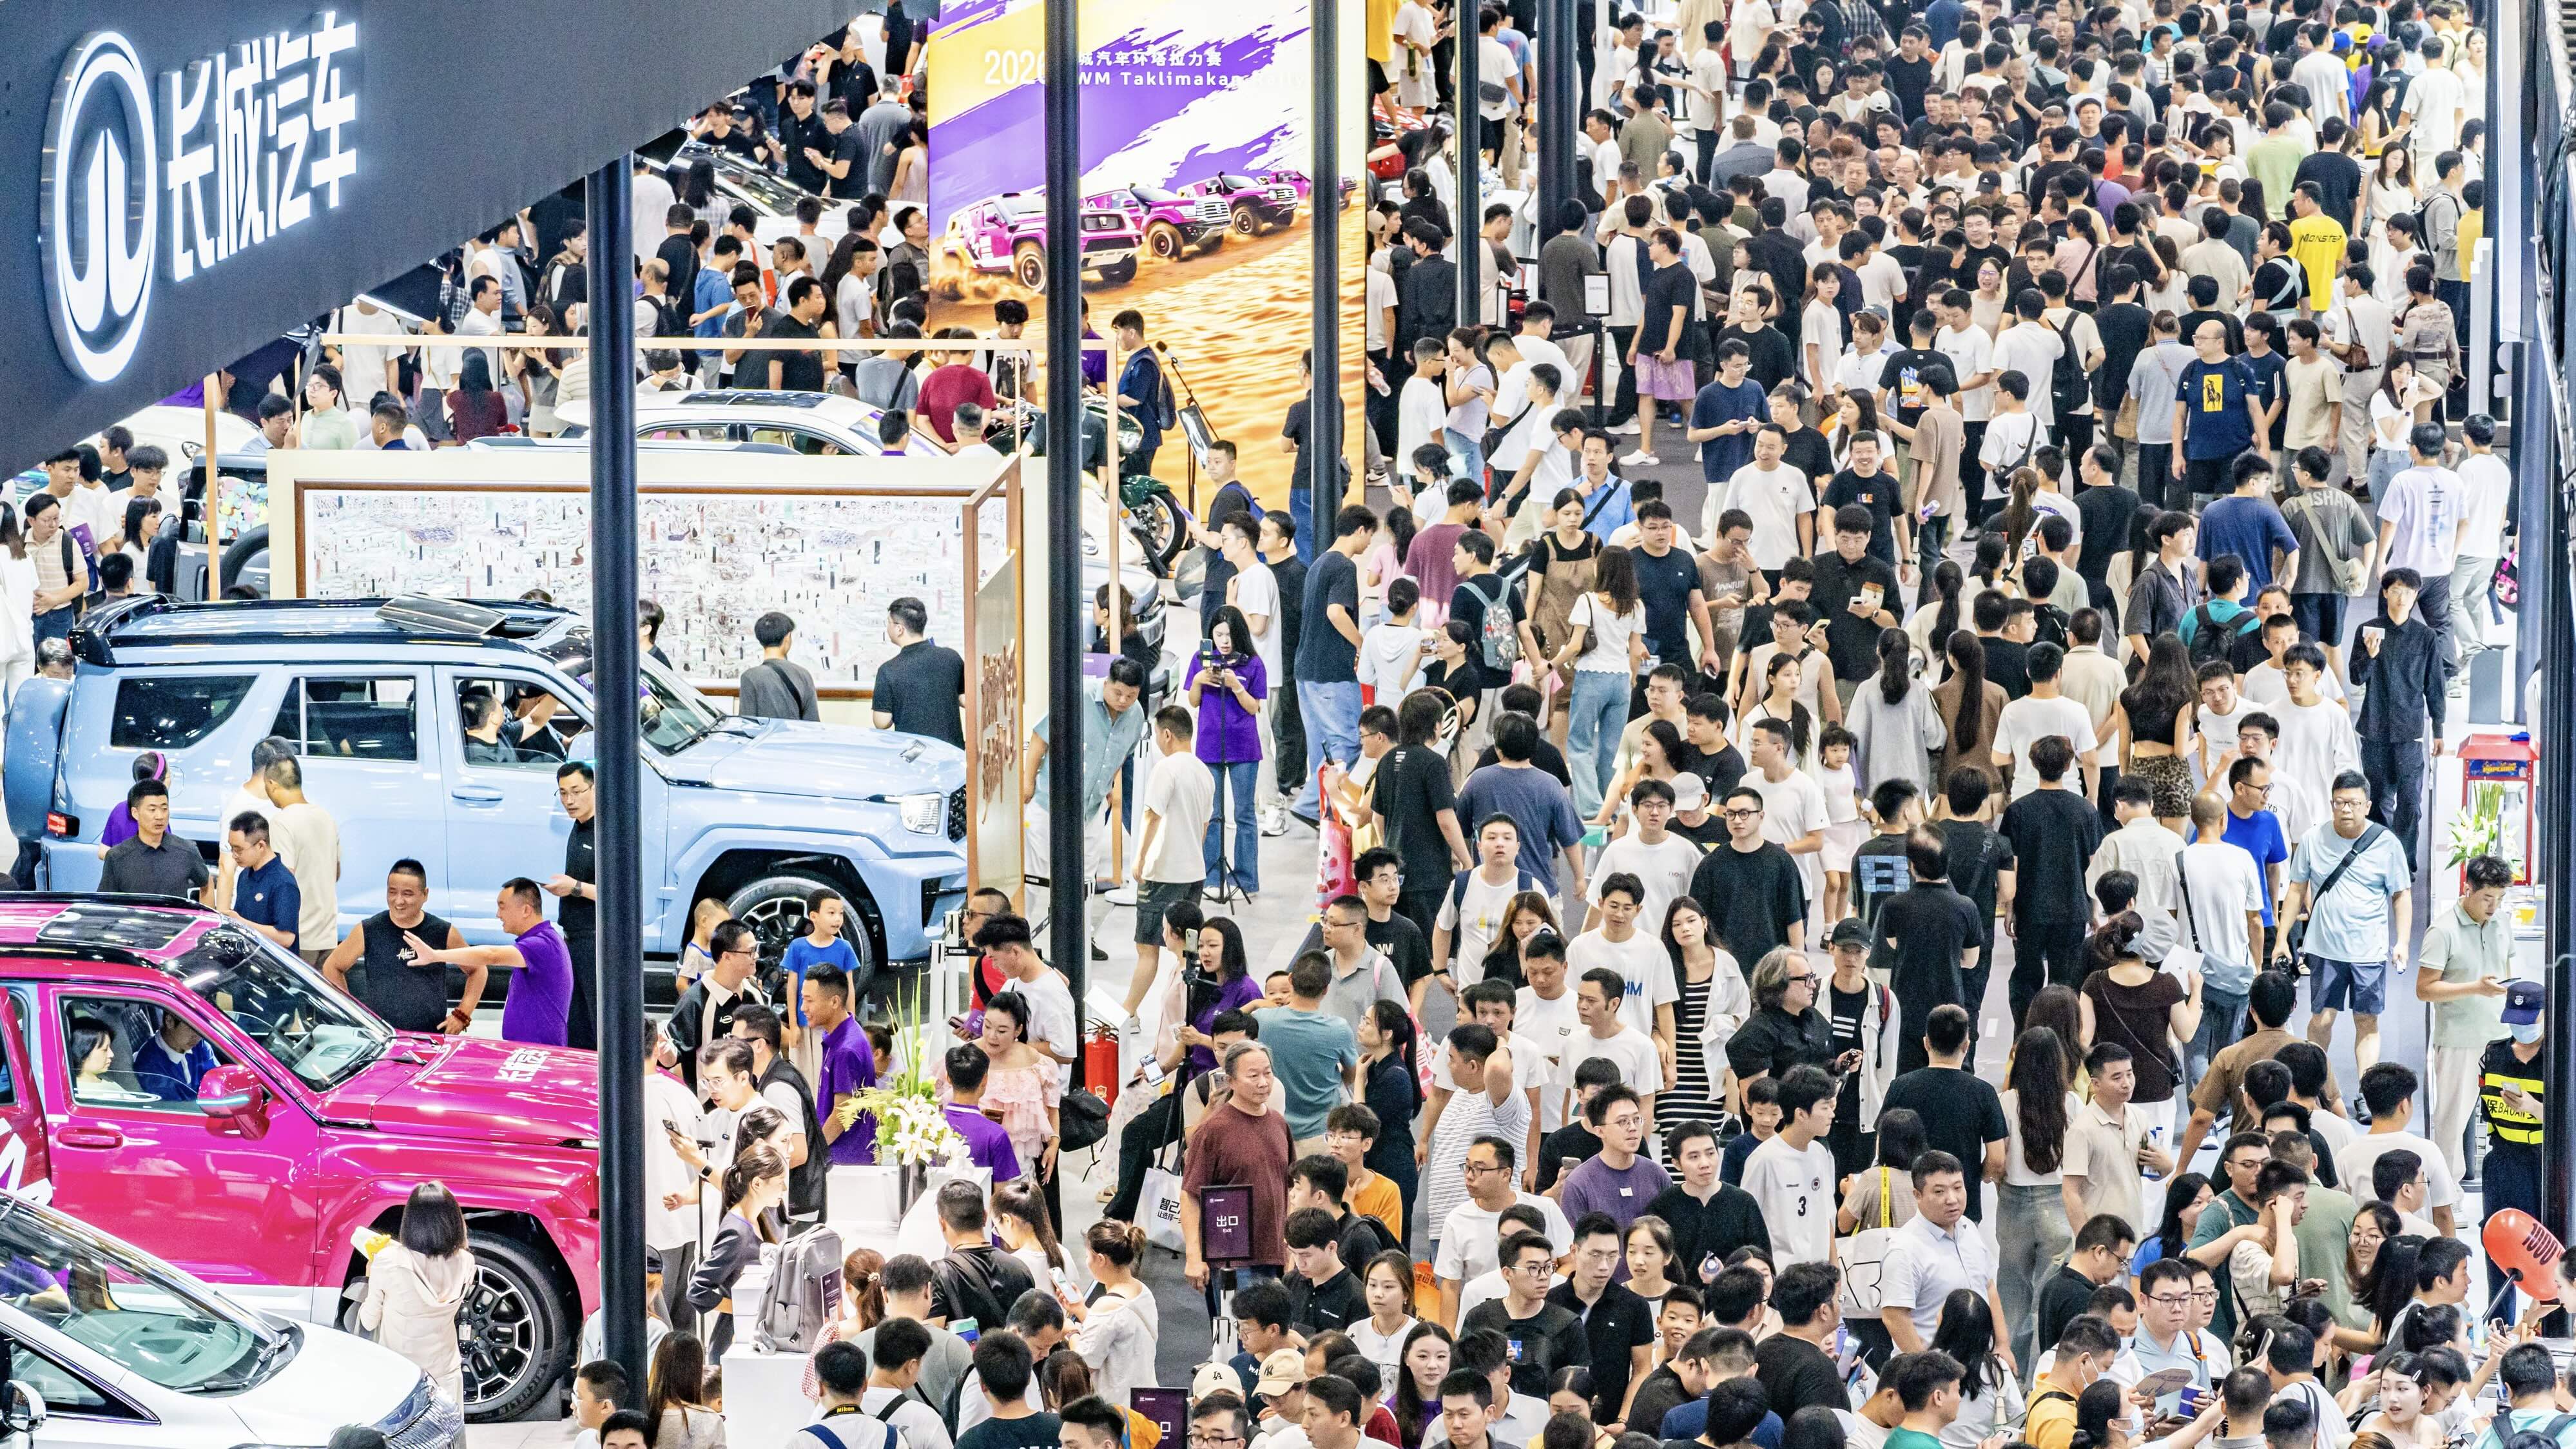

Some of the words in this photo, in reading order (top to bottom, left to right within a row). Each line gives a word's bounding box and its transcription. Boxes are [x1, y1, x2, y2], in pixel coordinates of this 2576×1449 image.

[1079, 51, 1222, 66] 城汽车环塔拉力赛
[1079, 72, 1110, 85] WM
[167, 10, 357, 282] 长城汽车
[1159, 1197, 1181, 1214] 智己
[1797, 1196, 1806, 1217] 3
[1157, 1210, 1181, 1224] 让选择一
[1216, 1215, 1239, 1227] 出口
[1212, 1370, 1223, 1381] LA
[1161, 1421, 1171, 1432] 口
